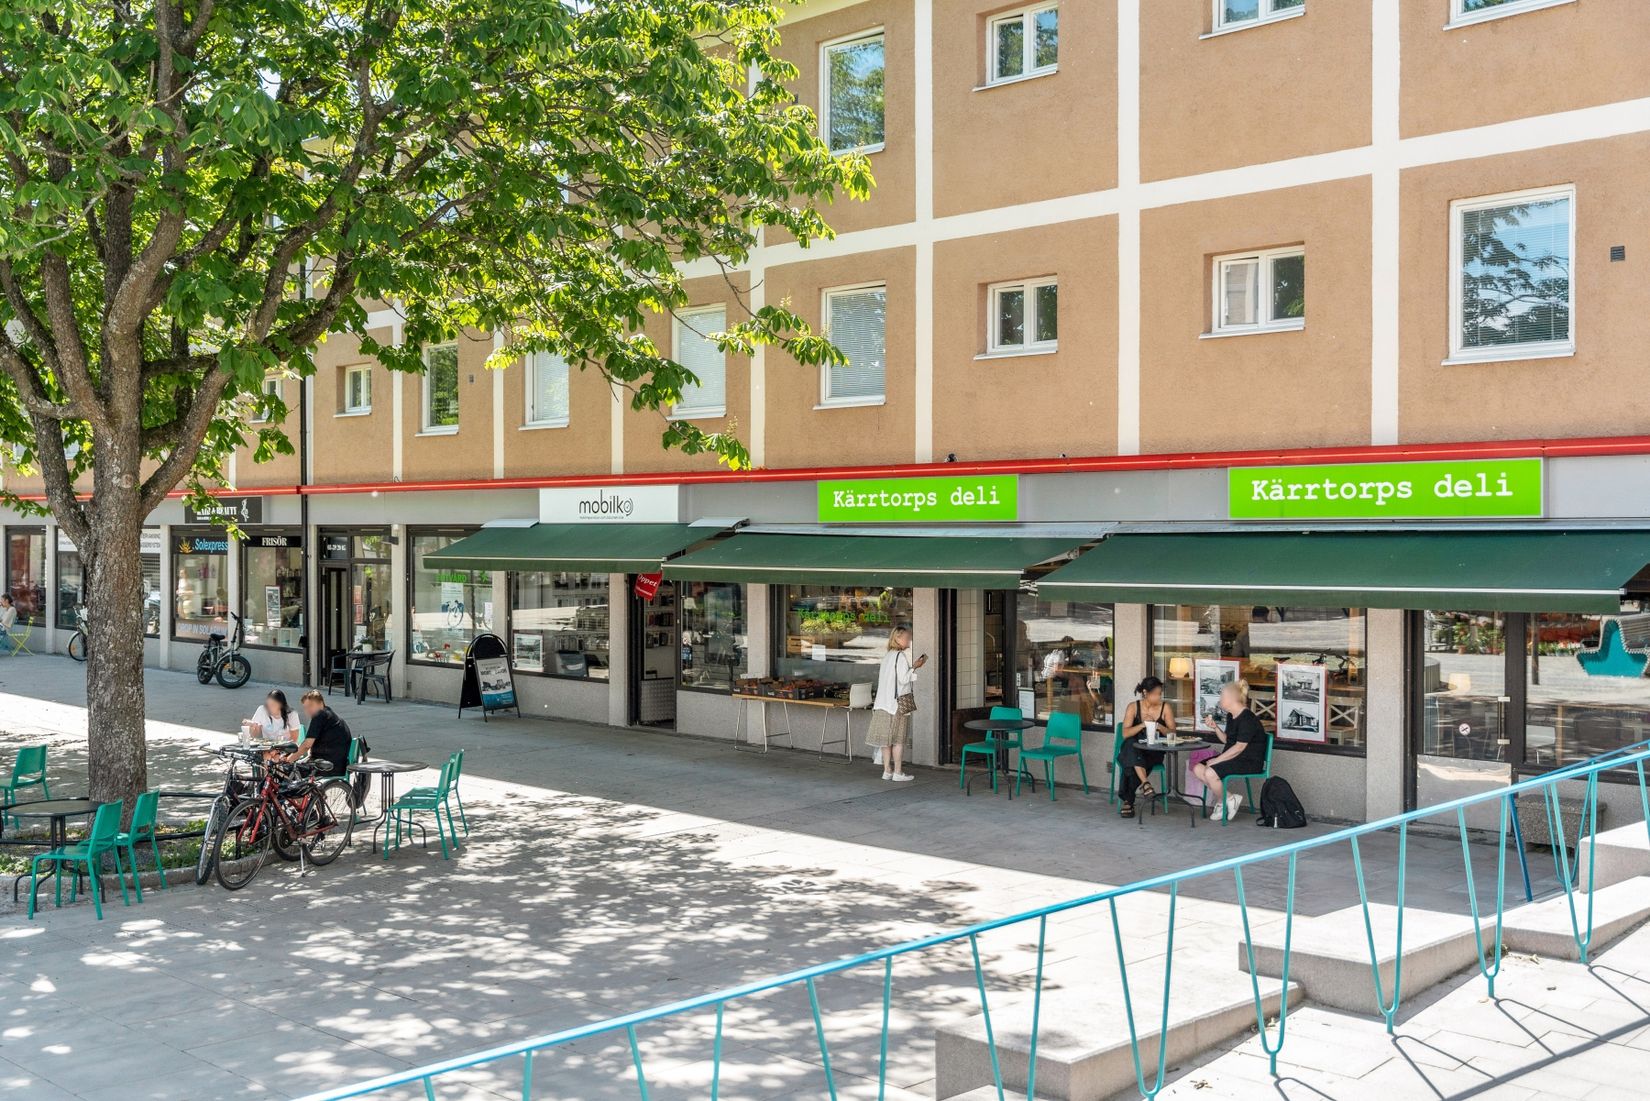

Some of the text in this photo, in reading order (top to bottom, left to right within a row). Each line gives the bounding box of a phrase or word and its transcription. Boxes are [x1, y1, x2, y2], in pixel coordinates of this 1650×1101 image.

[834, 486, 999, 512] Kärrtorps deli
[1251, 473, 1513, 505] Kärrtorps deli
[195, 538, 229, 553] Solexpress
[262, 535, 287, 547] FRISÖR
